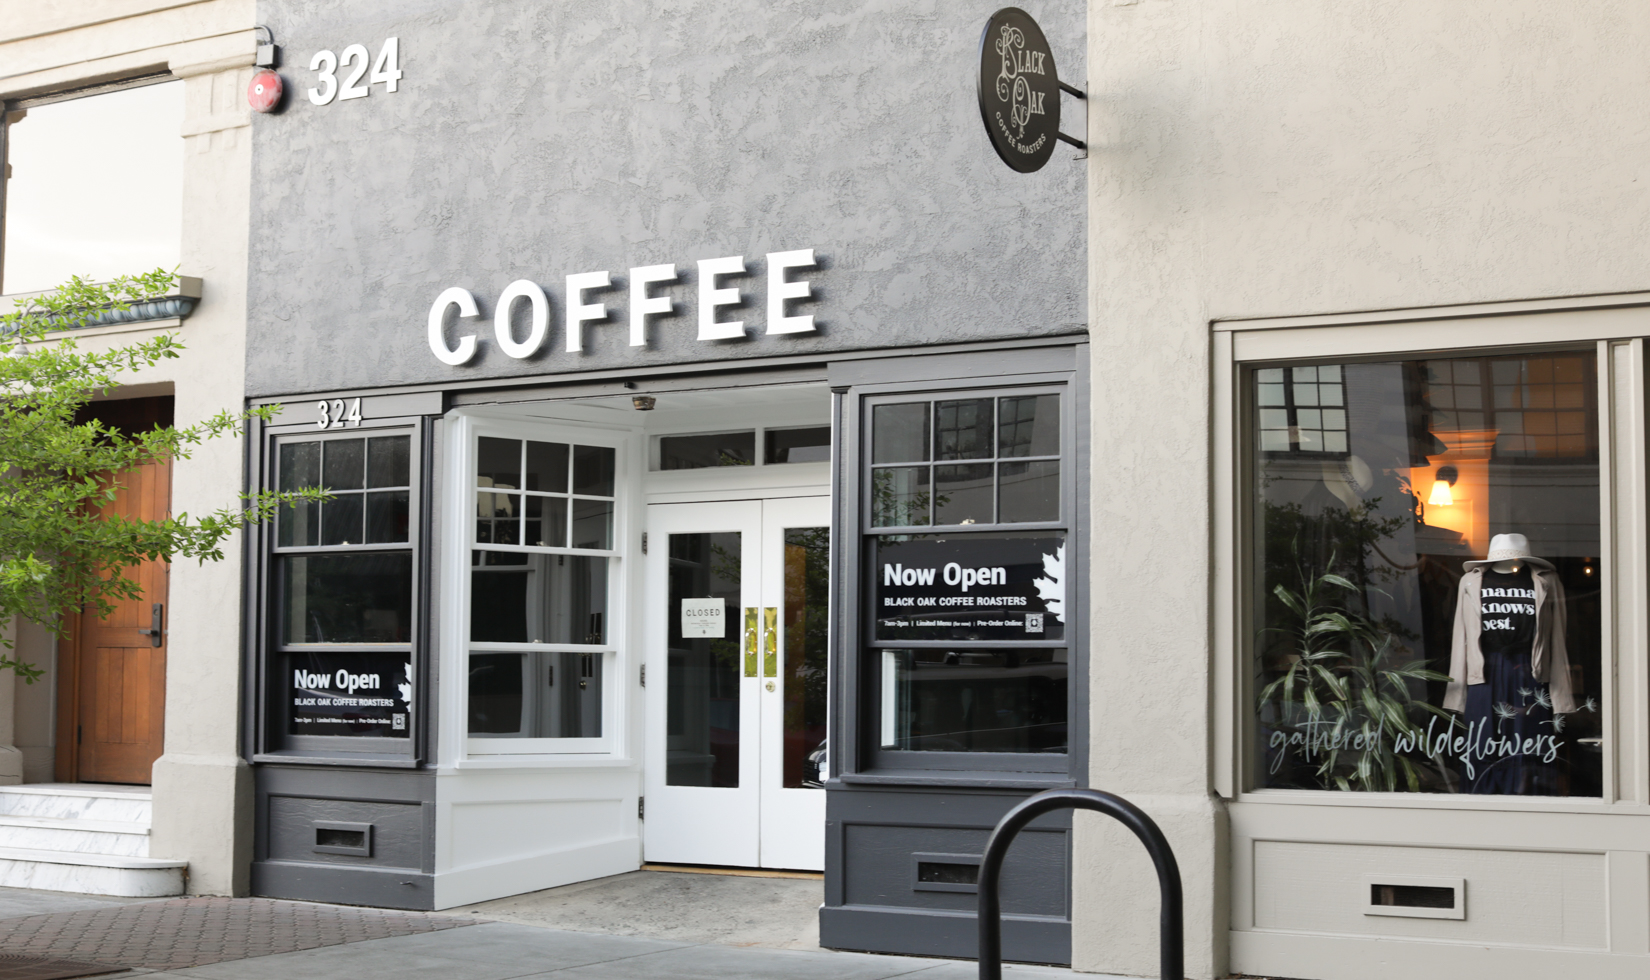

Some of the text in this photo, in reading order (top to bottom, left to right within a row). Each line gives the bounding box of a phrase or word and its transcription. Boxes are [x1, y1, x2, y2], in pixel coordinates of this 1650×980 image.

[308, 37, 403, 106] 324
[996, 111, 1046, 154] COFFEE ROASTERS
[427, 248, 818, 366] COFFEE
[317, 397, 362, 429] 324
[884, 562, 1007, 592] Now Open
[686, 608, 721, 617] CLOSED
[884, 596, 1027, 606] BLACK OAK COFFEE ROASTERS
[294, 669, 380, 694] Now Open
[294, 698, 394, 707] BLACK OAK COFFEE ROASTERS
[1269, 711, 1565, 780] gathered wildeflowers
